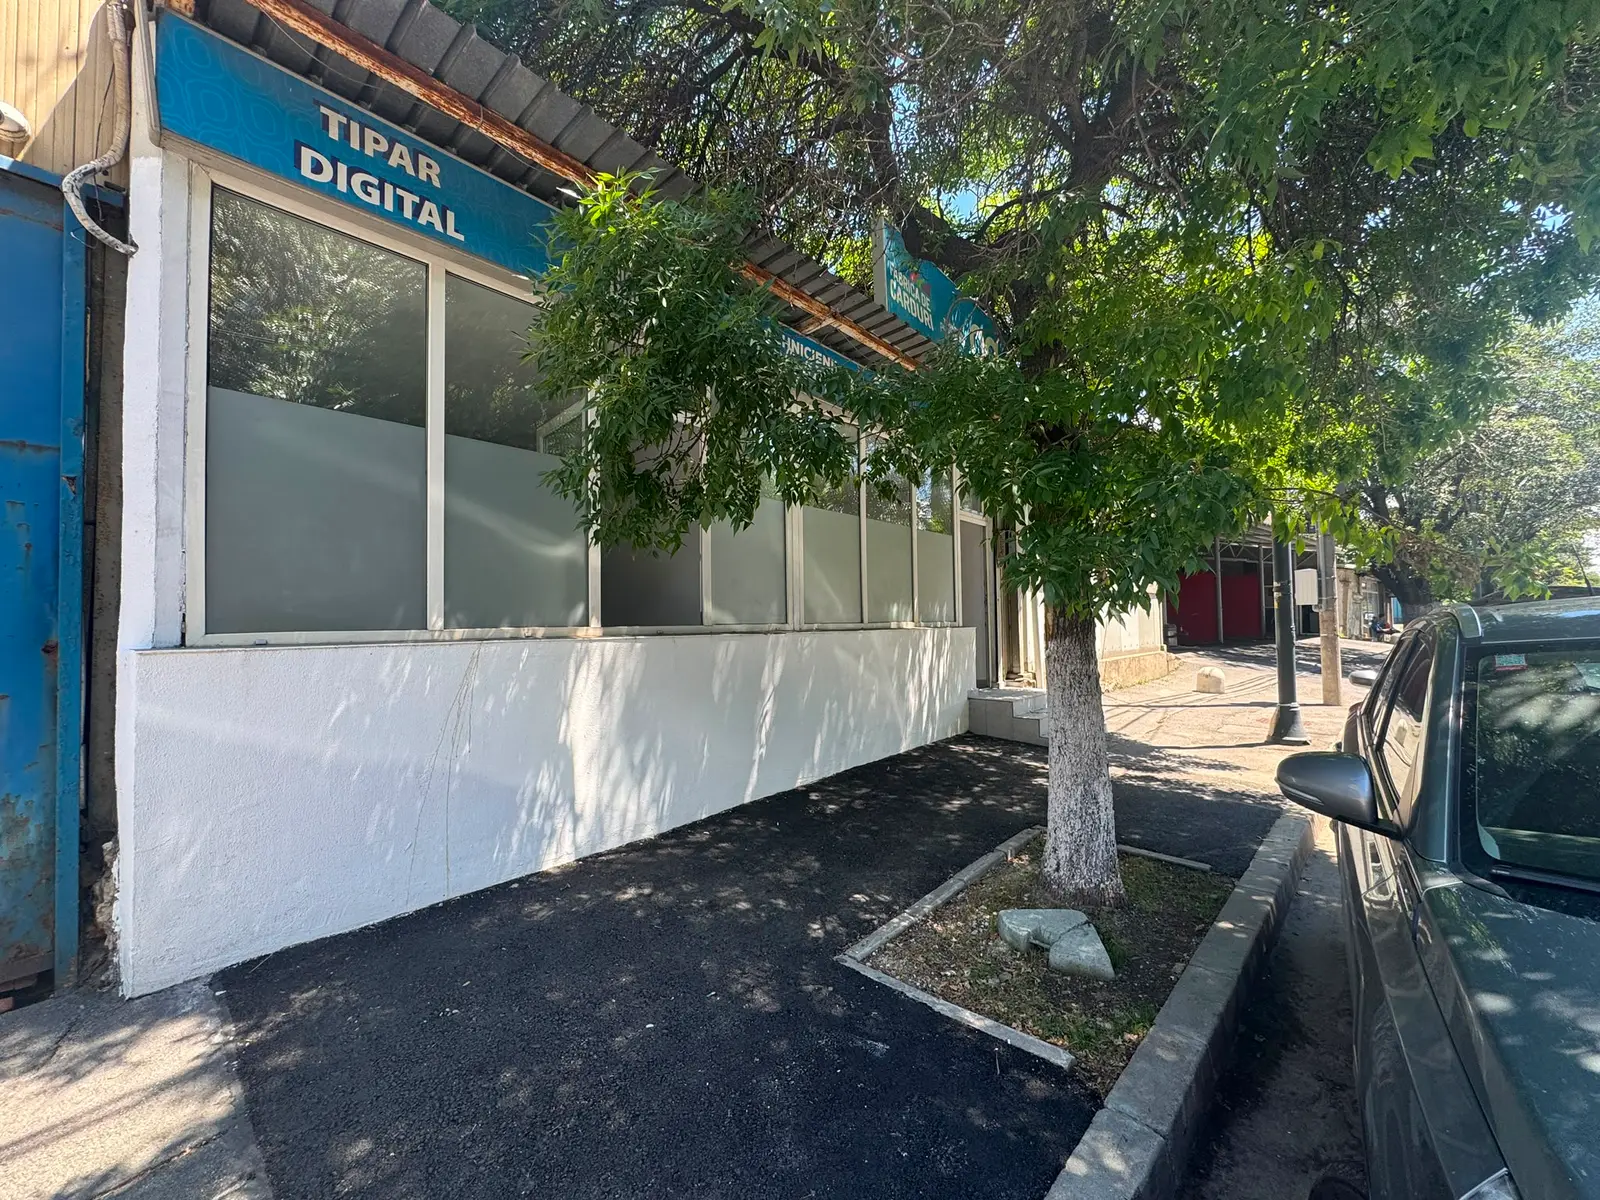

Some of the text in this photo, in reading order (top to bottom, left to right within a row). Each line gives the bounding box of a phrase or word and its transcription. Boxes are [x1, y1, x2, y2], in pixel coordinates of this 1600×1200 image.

[319, 105, 441, 188] TIPAR
[301, 146, 465, 242] DIGITAL
[889, 261, 931, 311] FABRICA DE
[890, 279, 934, 331] CARDURI
